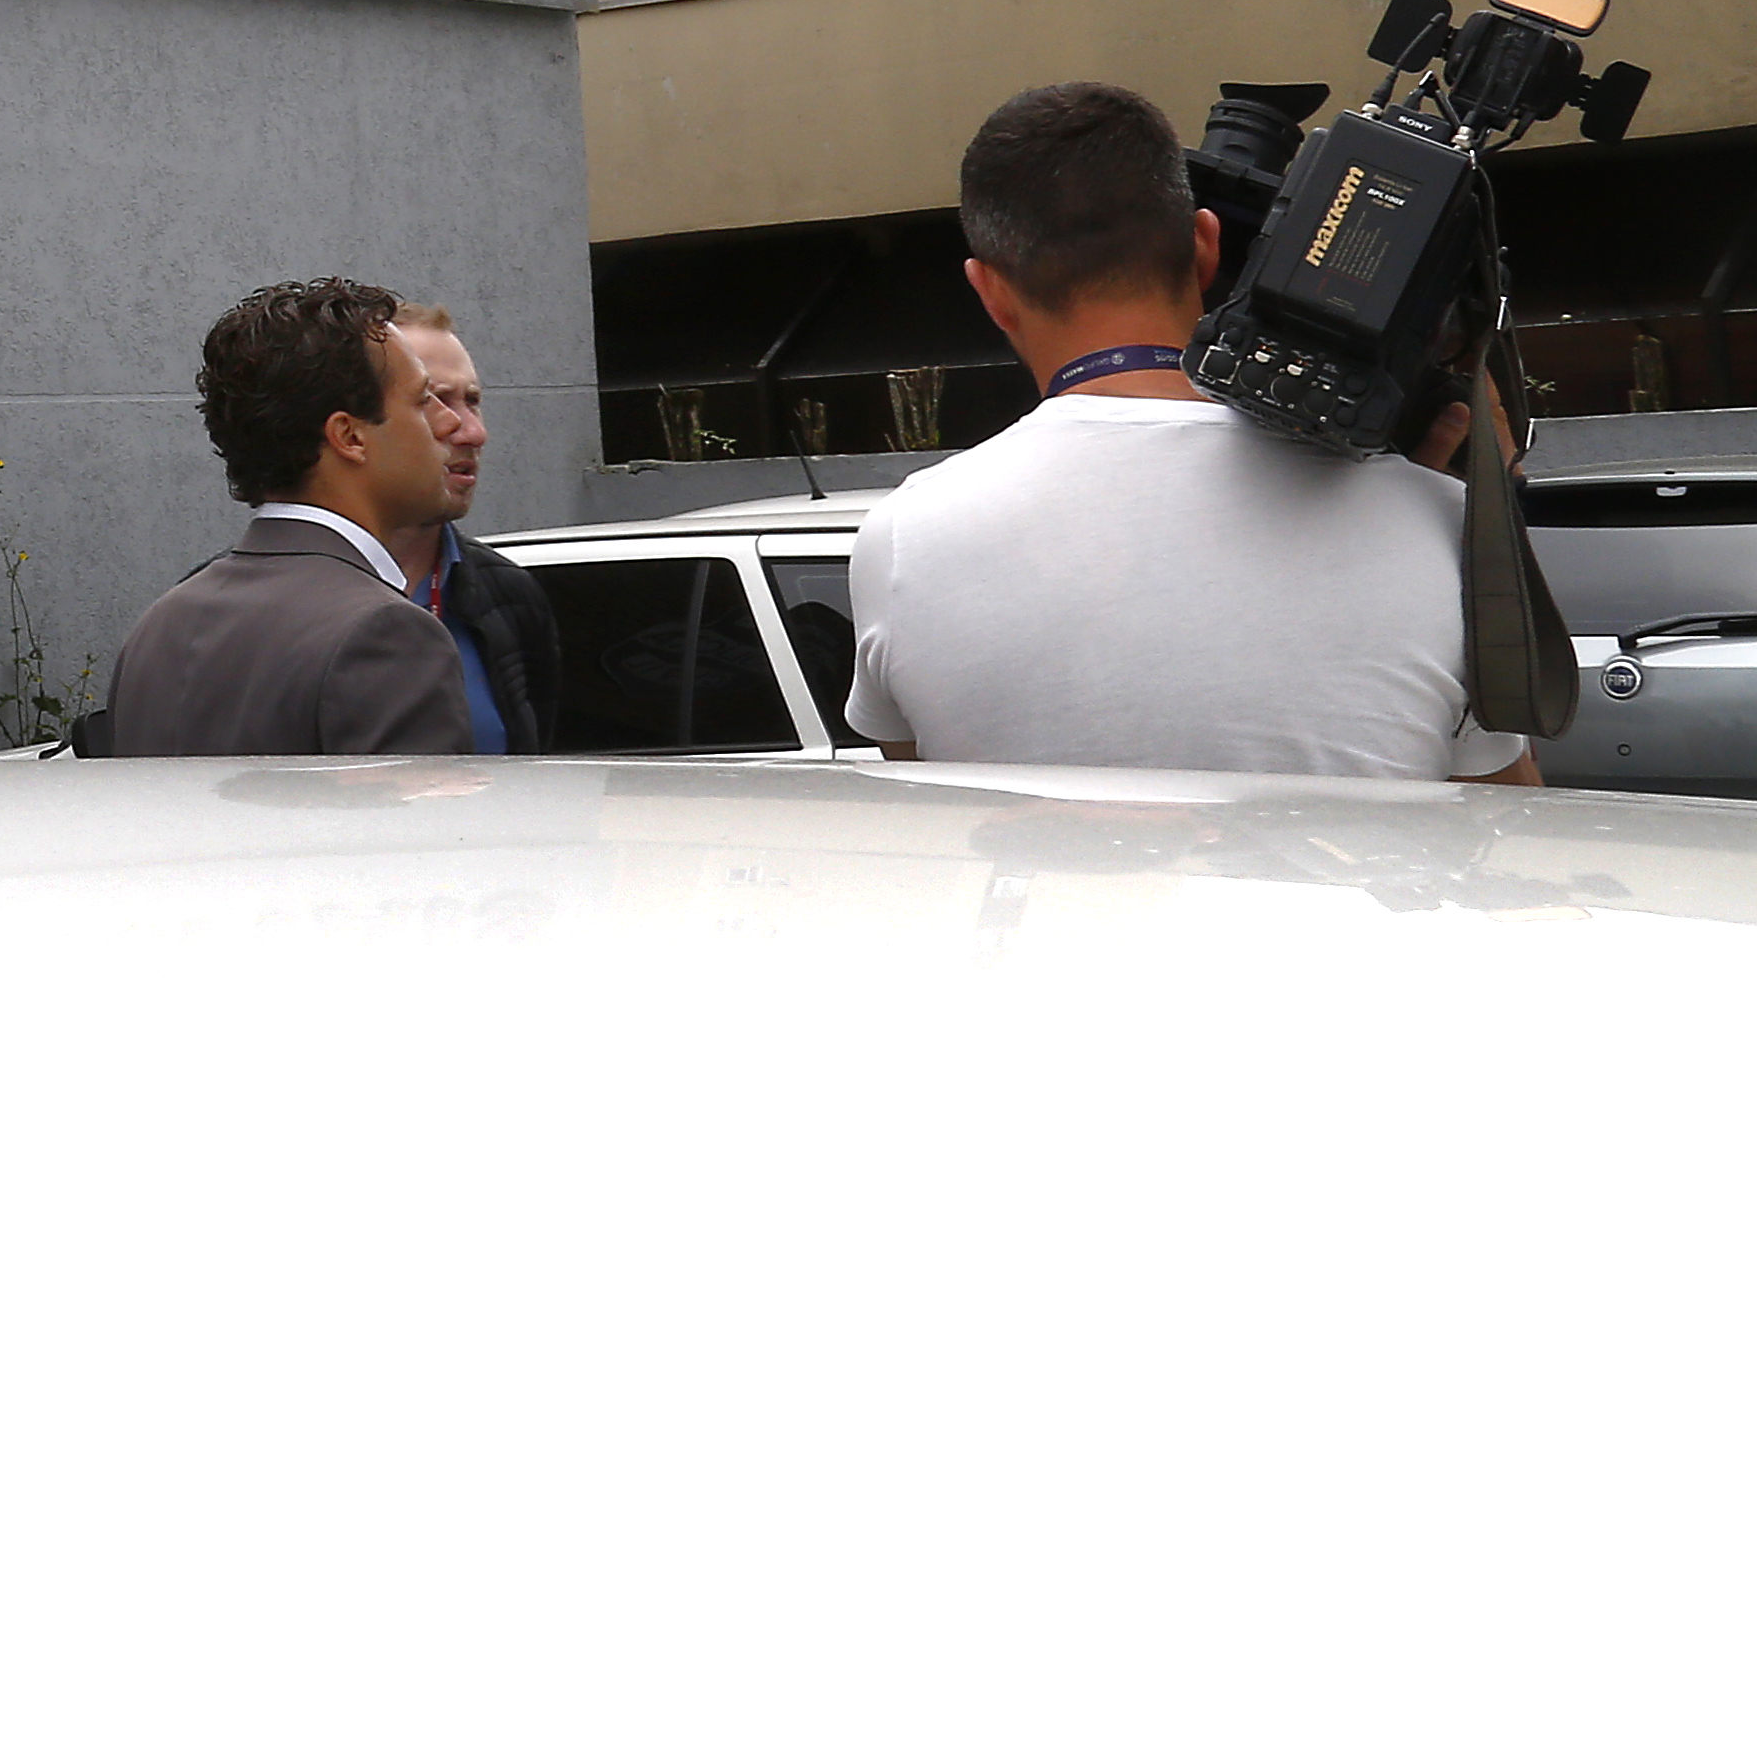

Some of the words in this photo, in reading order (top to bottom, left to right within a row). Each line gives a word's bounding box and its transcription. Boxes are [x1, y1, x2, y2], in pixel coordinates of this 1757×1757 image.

[1396, 114, 1434, 133] SONY
[1304, 165, 1366, 268] maxicom
[1607, 674, 1634, 687] FIAT
